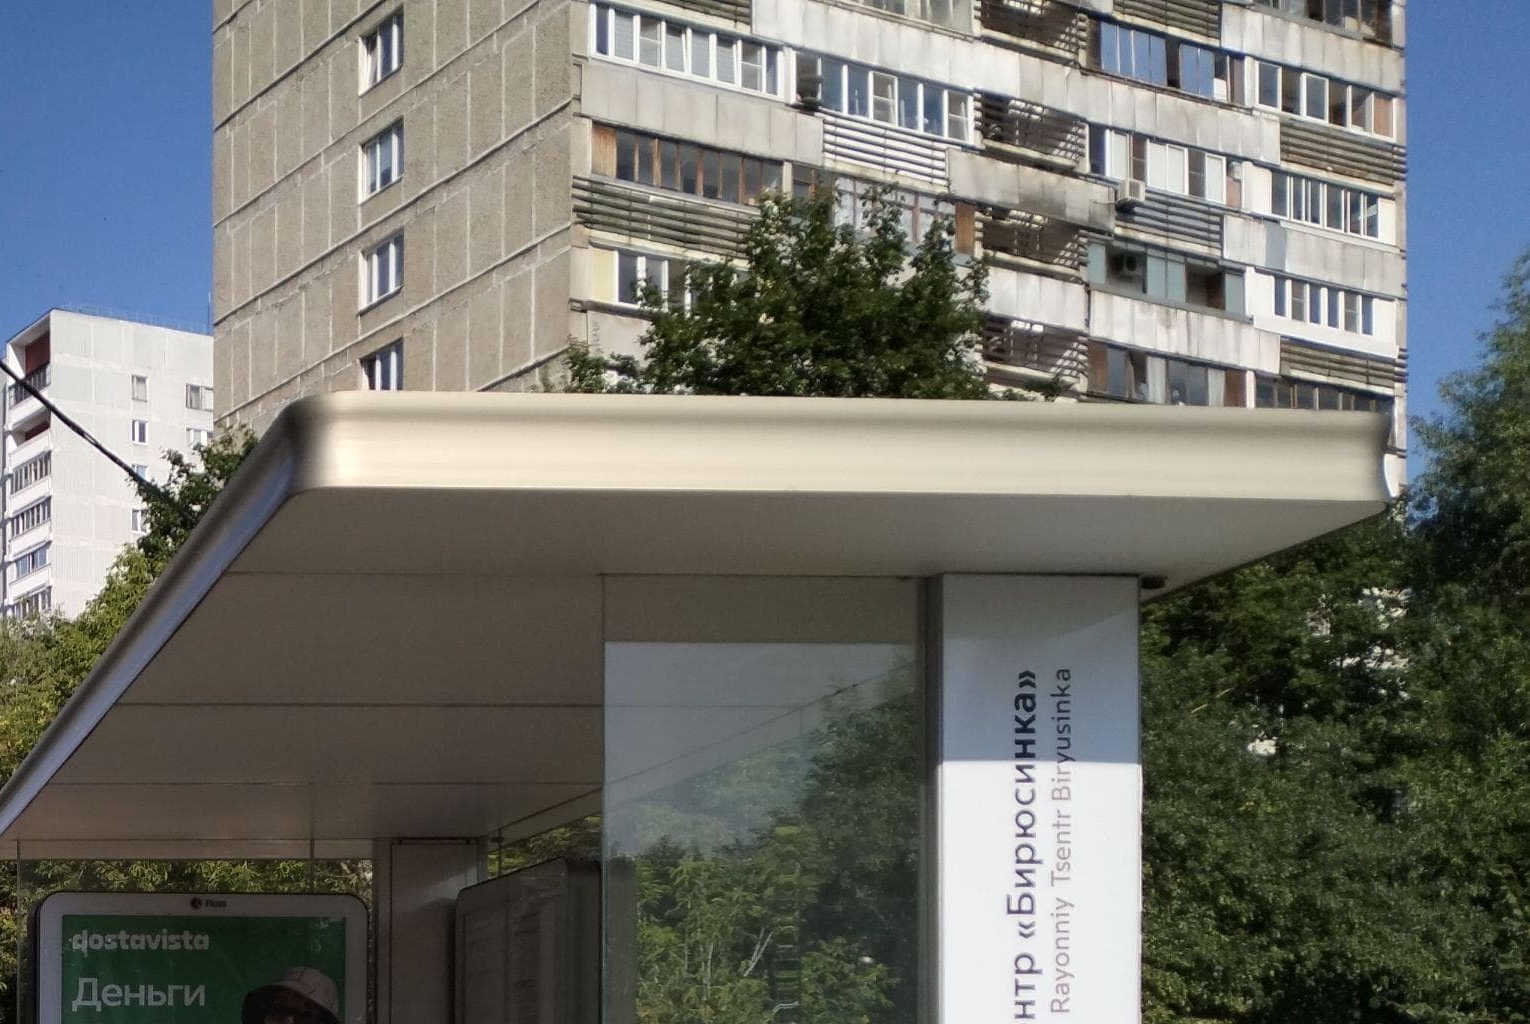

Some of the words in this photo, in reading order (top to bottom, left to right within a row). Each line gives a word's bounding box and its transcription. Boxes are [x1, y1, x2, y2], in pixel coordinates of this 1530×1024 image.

[1051, 667, 1075, 802] Biryusinka
[1006, 669, 1043, 940] «Бирюсинка»
[1051, 808, 1072, 888] Tsentr
[72, 929, 210, 950] dostavista
[1050, 897, 1075, 1014] Rayonniy
[72, 977, 206, 1012] Деньги
